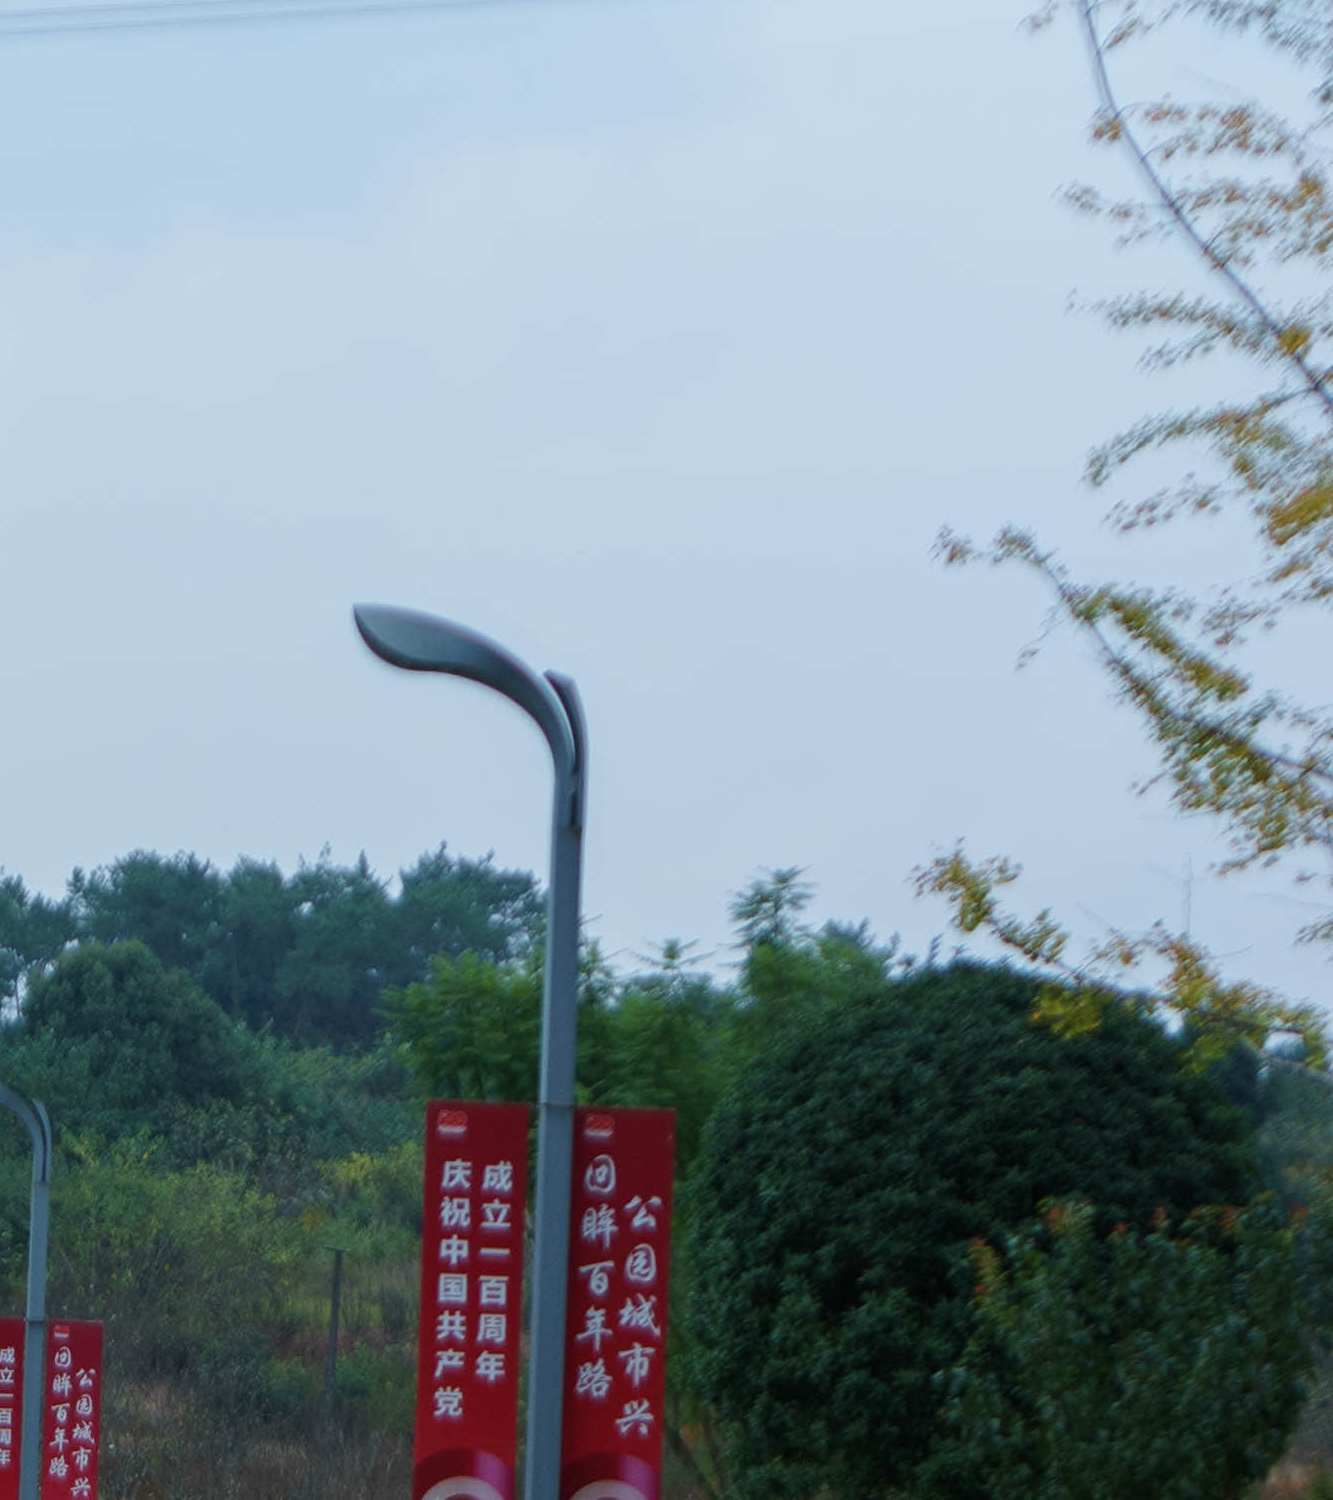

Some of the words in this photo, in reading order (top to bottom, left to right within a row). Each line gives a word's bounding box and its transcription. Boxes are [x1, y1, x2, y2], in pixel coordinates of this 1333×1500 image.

[433, 1159, 473, 1418] 庆祝中国共产党
[475, 1161, 514, 1381] 成立一百周年
[576, 1155, 618, 1397] 回眸百年路
[616, 1196, 662, 1435] 公园城市兴
[48, 1347, 73, 1476] 回眸百年路
[70, 1368, 95, 1497] 公园城市兴
